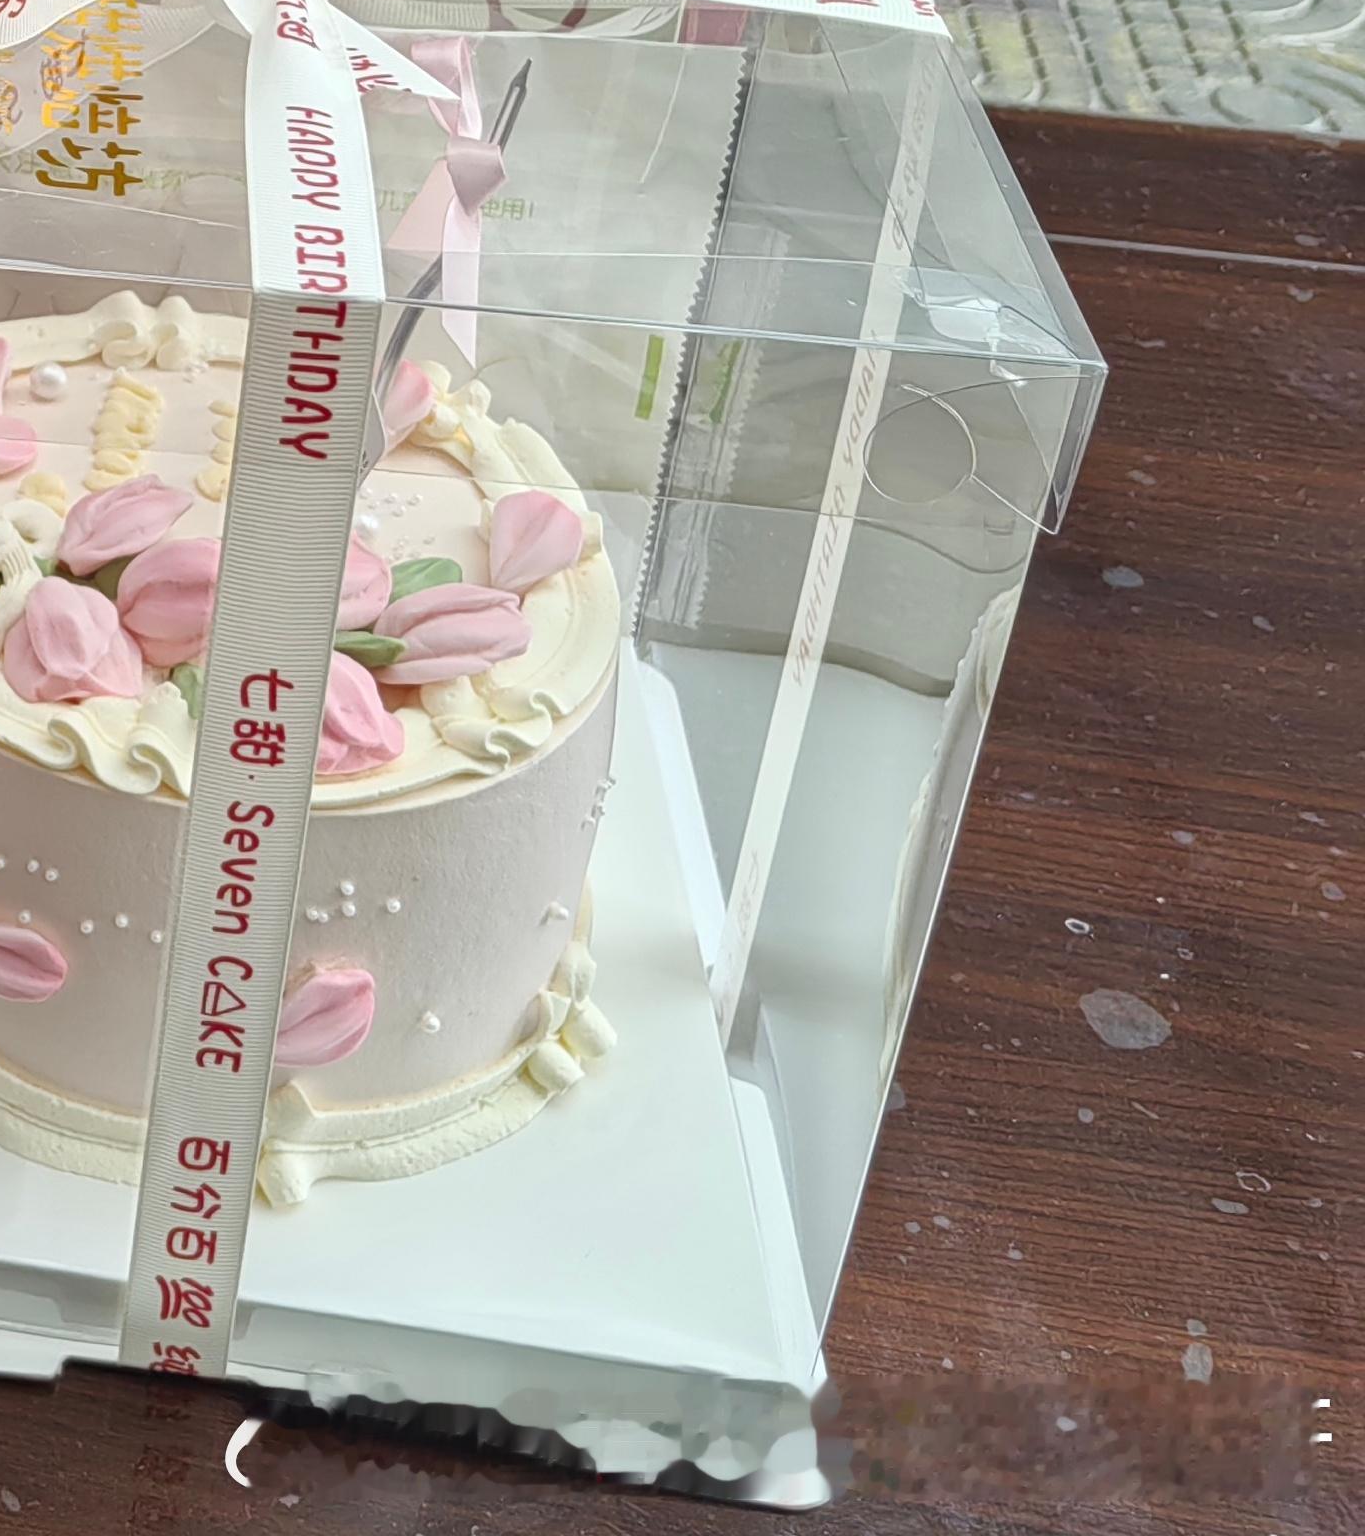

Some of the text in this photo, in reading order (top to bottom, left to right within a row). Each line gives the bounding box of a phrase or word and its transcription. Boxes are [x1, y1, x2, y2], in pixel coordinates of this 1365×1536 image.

[278, 224, 347, 460] BIRTHDAY
[211, 799, 276, 935] Seven
[165, 1137, 231, 1265] 百分百
